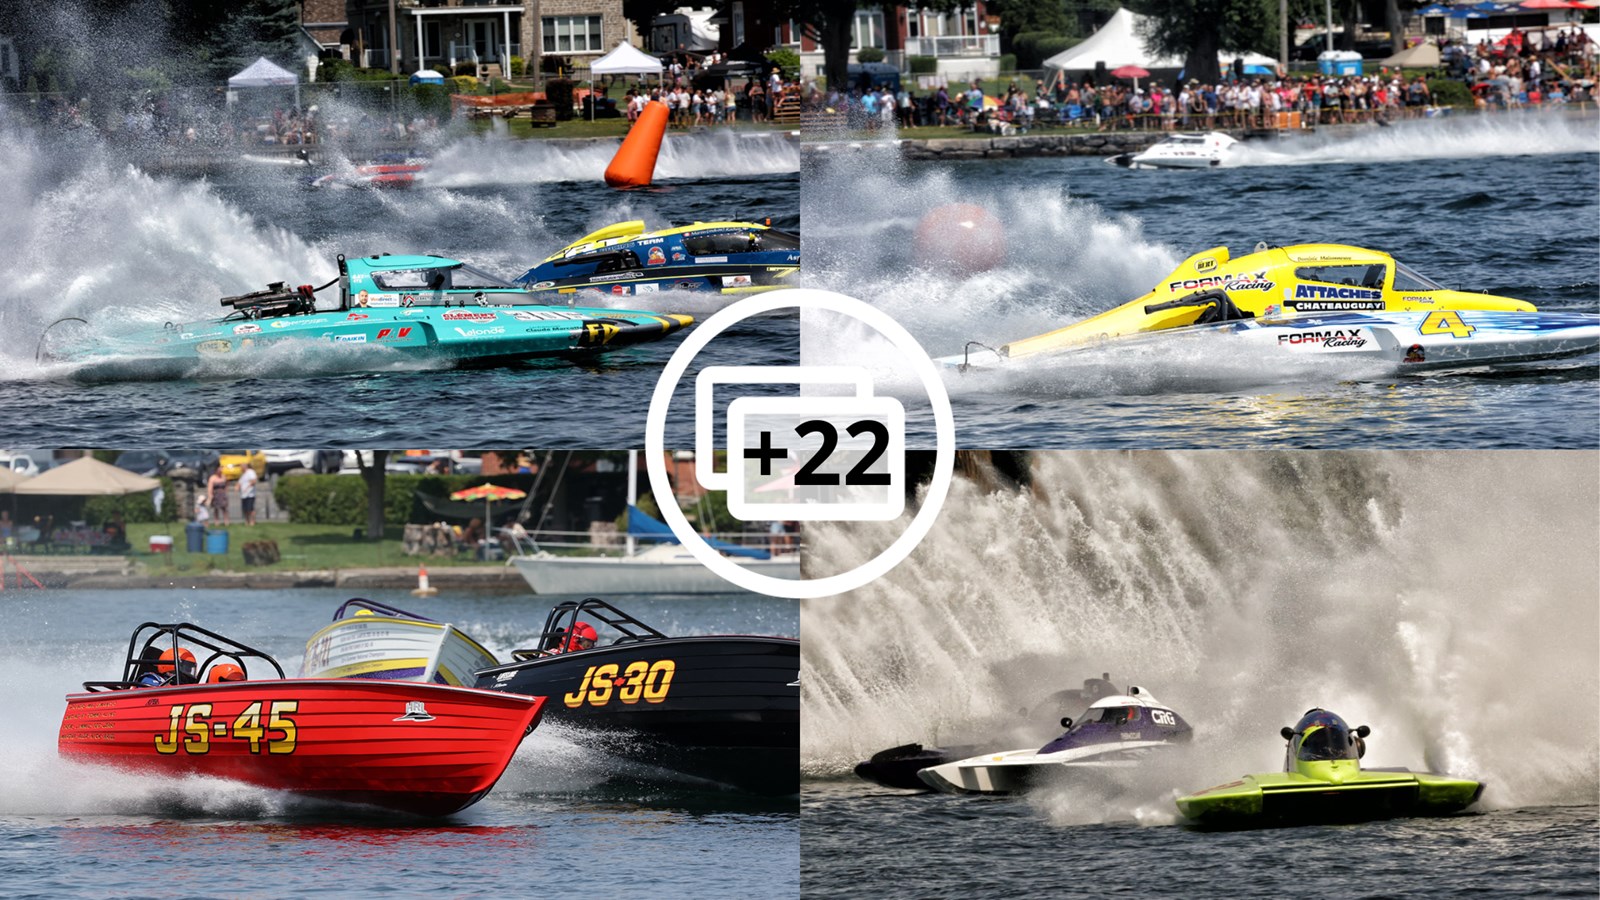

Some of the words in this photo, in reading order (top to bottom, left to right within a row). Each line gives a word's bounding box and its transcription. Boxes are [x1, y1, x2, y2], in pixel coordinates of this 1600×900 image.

[1169, 271, 1268, 292] FORMAX
[1224, 279, 1275, 292] Racing
[1295, 284, 1383, 300] ATTACHES
[1295, 301, 1381, 311] CHATEAUGUAY
[1419, 310, 1477, 338] 4
[1278, 328, 1362, 346] FORMAX
[1322, 336, 1367, 348] Racing
[154, 700, 299, 755] JS-45
